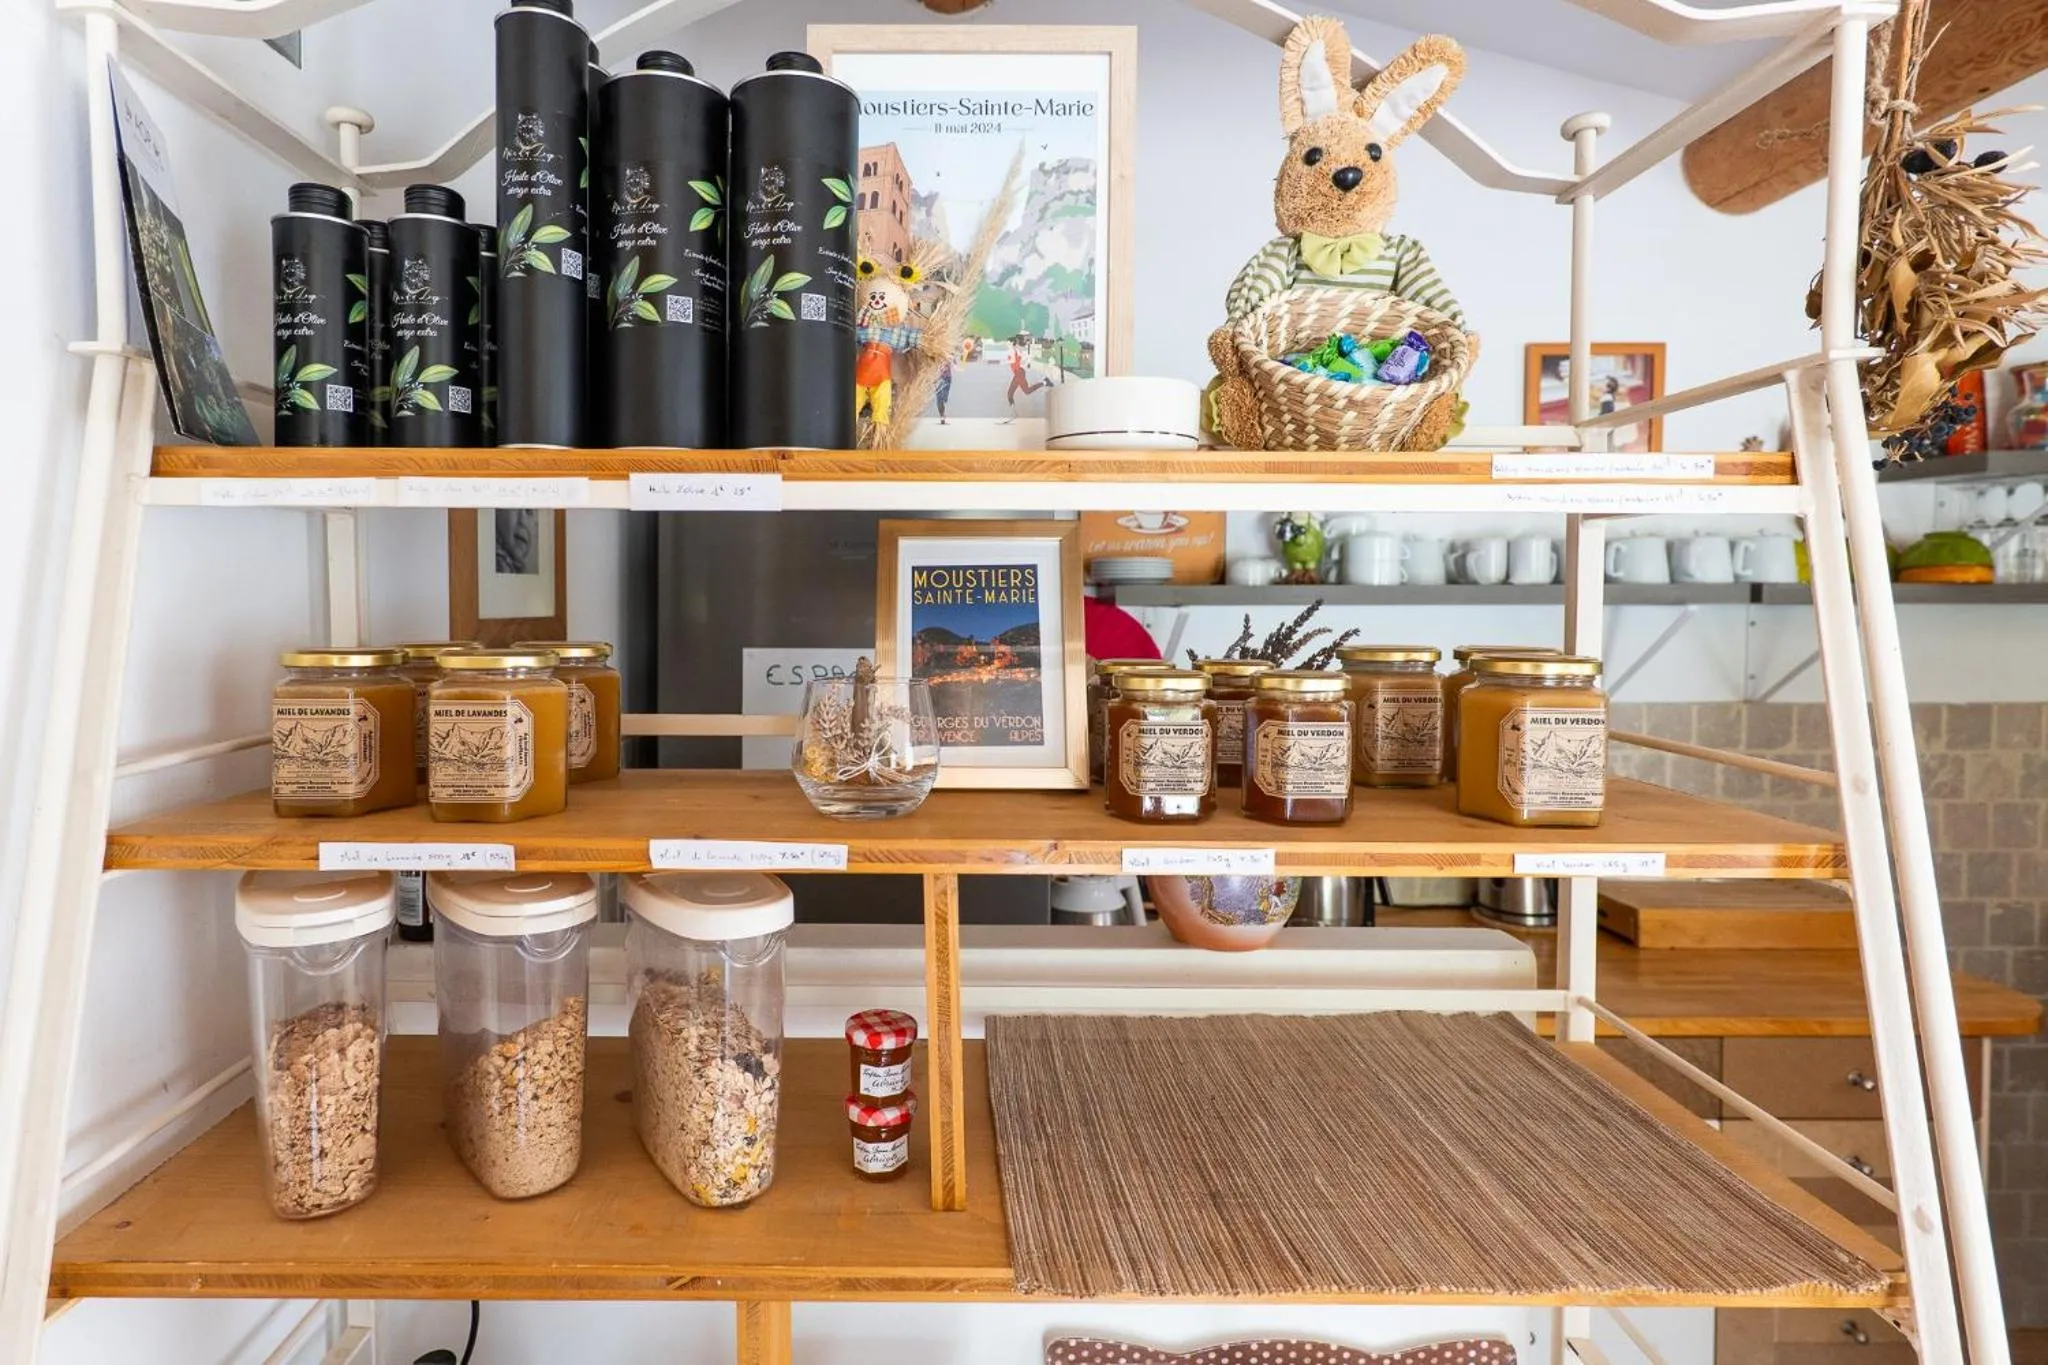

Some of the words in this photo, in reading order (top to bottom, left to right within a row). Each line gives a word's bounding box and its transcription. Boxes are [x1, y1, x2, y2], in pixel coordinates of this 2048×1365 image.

[858, 97, 1094, 117] oustiers-Sainte-Marie
[945, 123, 968, 134] mai
[969, 123, 1002, 134] 2024
[914, 568, 1036, 589] MOUSTIERS
[914, 588, 1036, 605] SAINTE-MARIE
[765, 664, 857, 685] ESPA
[277, 708, 296, 716] MIEL
[298, 708, 308, 716] DE
[310, 708, 351, 716] LAVANDES
[434, 709, 453, 717] MIEL
[455, 709, 465, 717] DE
[466, 709, 508, 717] LAVANDES
[974, 716, 990, 728] DU
[994, 715, 1043, 728] VERDON
[1530, 717, 1551, 725] MIEL
[1554, 717, 1567, 725] DU
[1009, 730, 1043, 742] ALPES
[1138, 728, 1157, 736] MIEL
[1158, 728, 1171, 736] DU
[1277, 729, 1296, 737] MIEL
[1297, 729, 1309, 737] DU
[1310, 729, 1344, 737] VERDON
